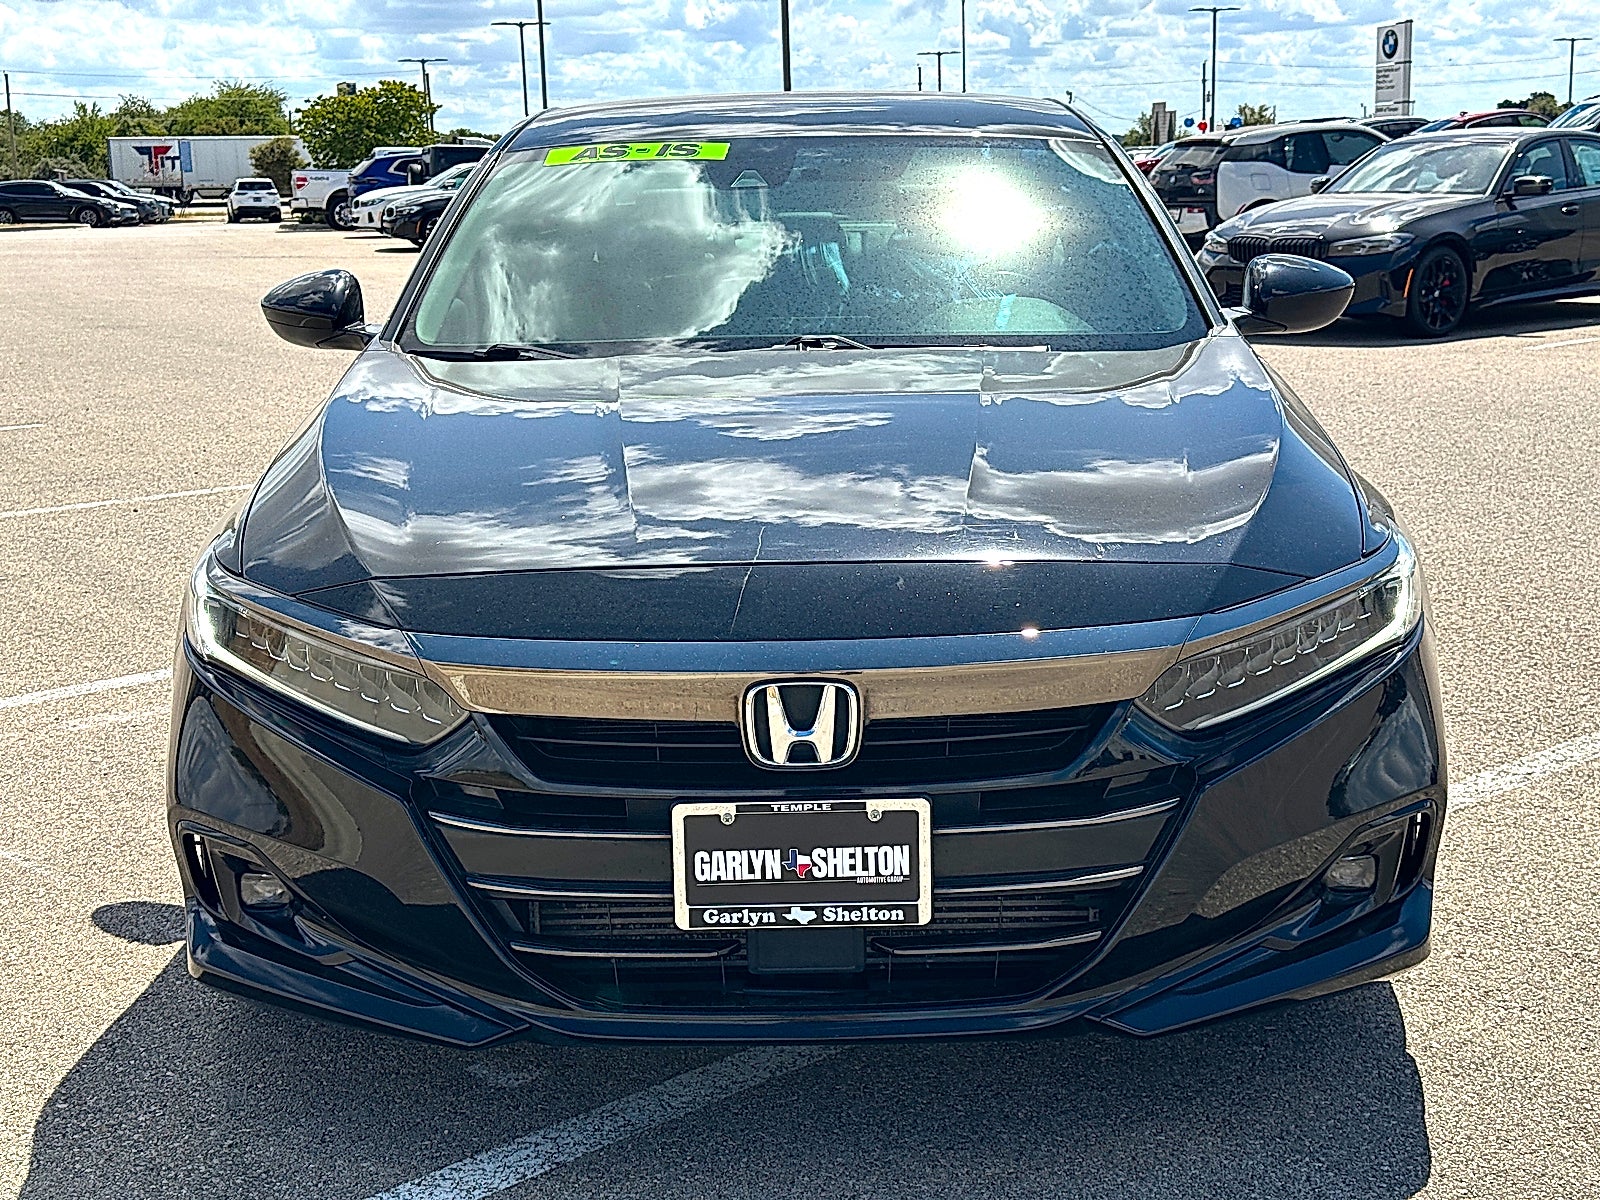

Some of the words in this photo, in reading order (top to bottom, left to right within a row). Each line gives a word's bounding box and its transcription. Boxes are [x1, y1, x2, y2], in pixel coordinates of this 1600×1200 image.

[771, 803, 832, 812] TEMPLE
[694, 849, 782, 882] GARLYN
[811, 845, 910, 878] SHELTON
[856, 876, 887, 884] AUTOMOTIVE
[886, 875, 904, 883] GROUP
[703, 908, 776, 926] Garlyn
[822, 906, 905, 922] Shelton
